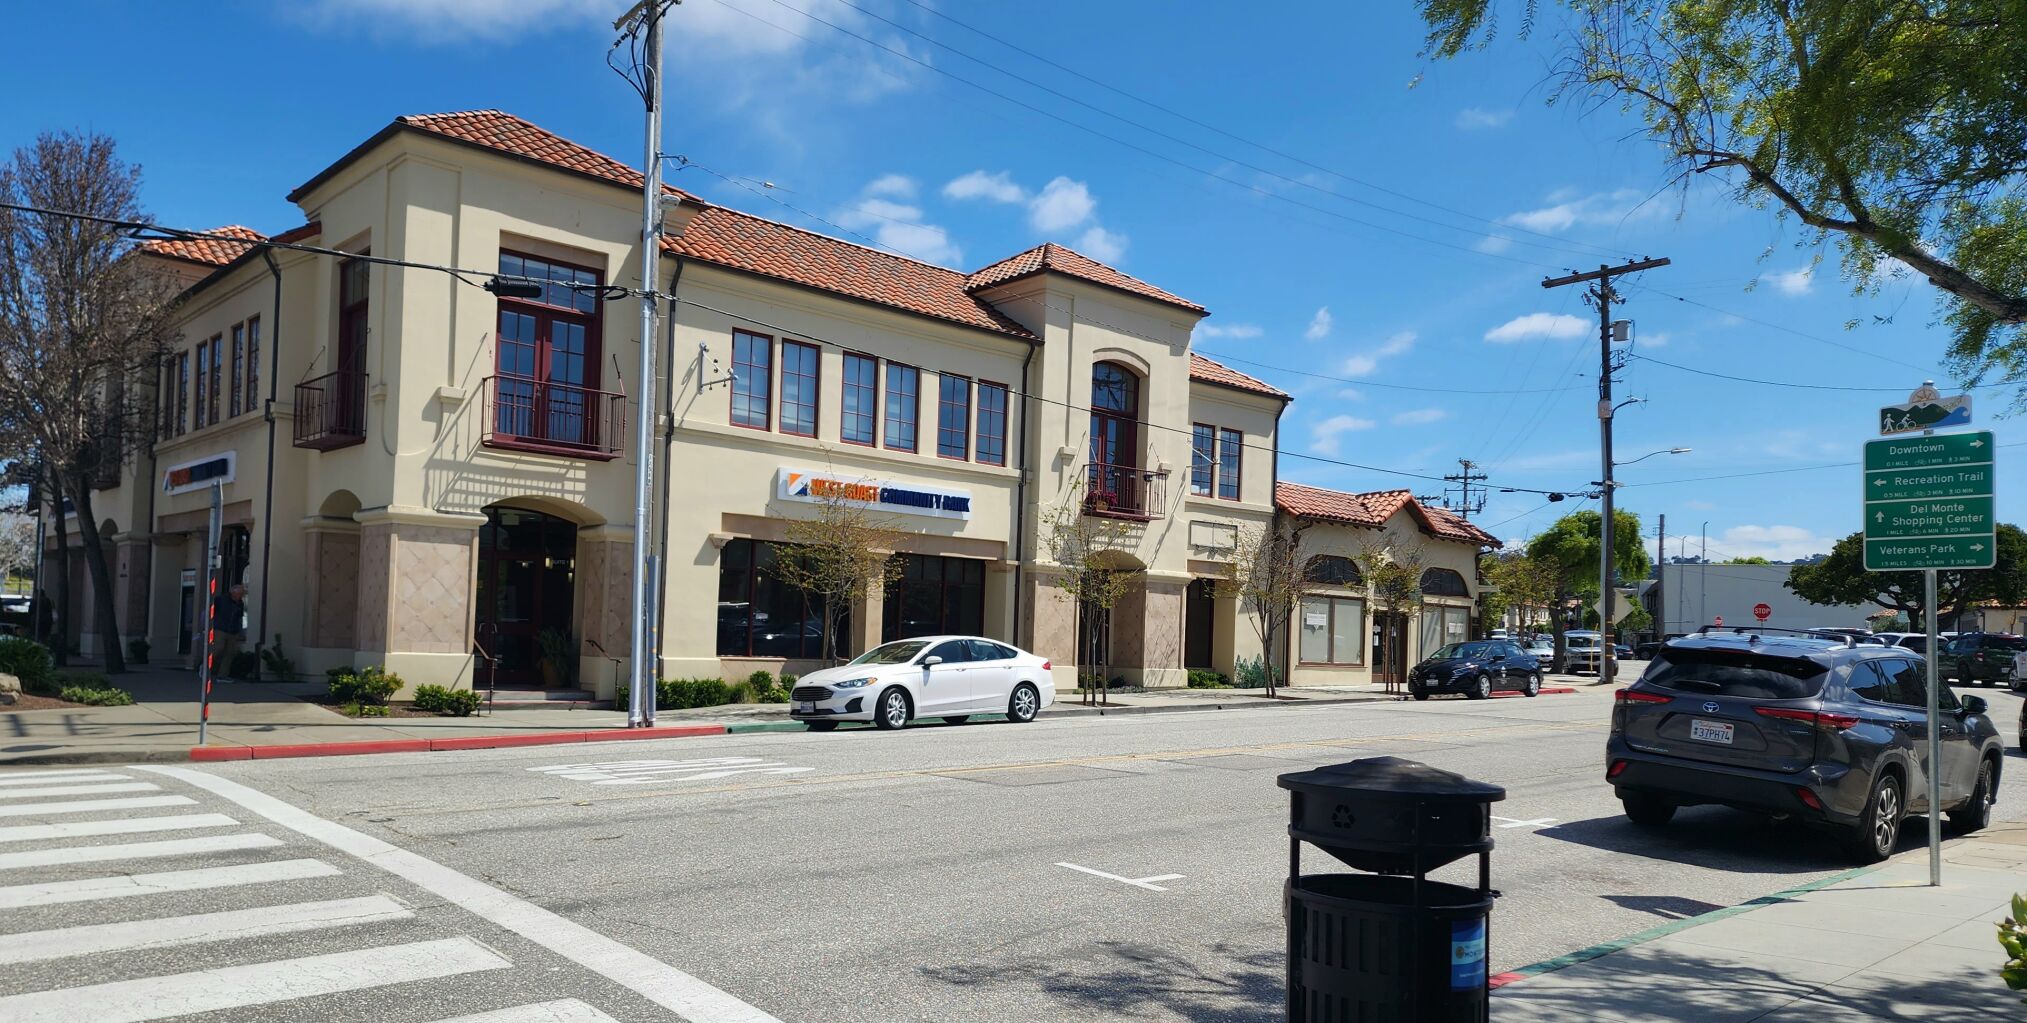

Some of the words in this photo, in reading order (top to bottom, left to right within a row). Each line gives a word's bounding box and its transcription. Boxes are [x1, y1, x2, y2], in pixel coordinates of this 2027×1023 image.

[1889, 444, 1945, 455] Downtown
[1895, 475, 1954, 485] Recreation
[1958, 472, 1984, 482] Trail
[811, 478, 843, 497] WEST
[844, 482, 880, 503] COAST
[880, 487, 942, 510] COMMUNITY
[942, 495, 971, 513] BANK
[1910, 504, 1928, 514] Del
[1931, 503, 1965, 513] Monte
[1892, 515, 1943, 527] Shopping
[1946, 513, 1984, 523] Center
[1880, 545, 1927, 555] Veterans
[1930, 543, 1956, 553] Park
[1699, 727, 1730, 741] 37PH74
